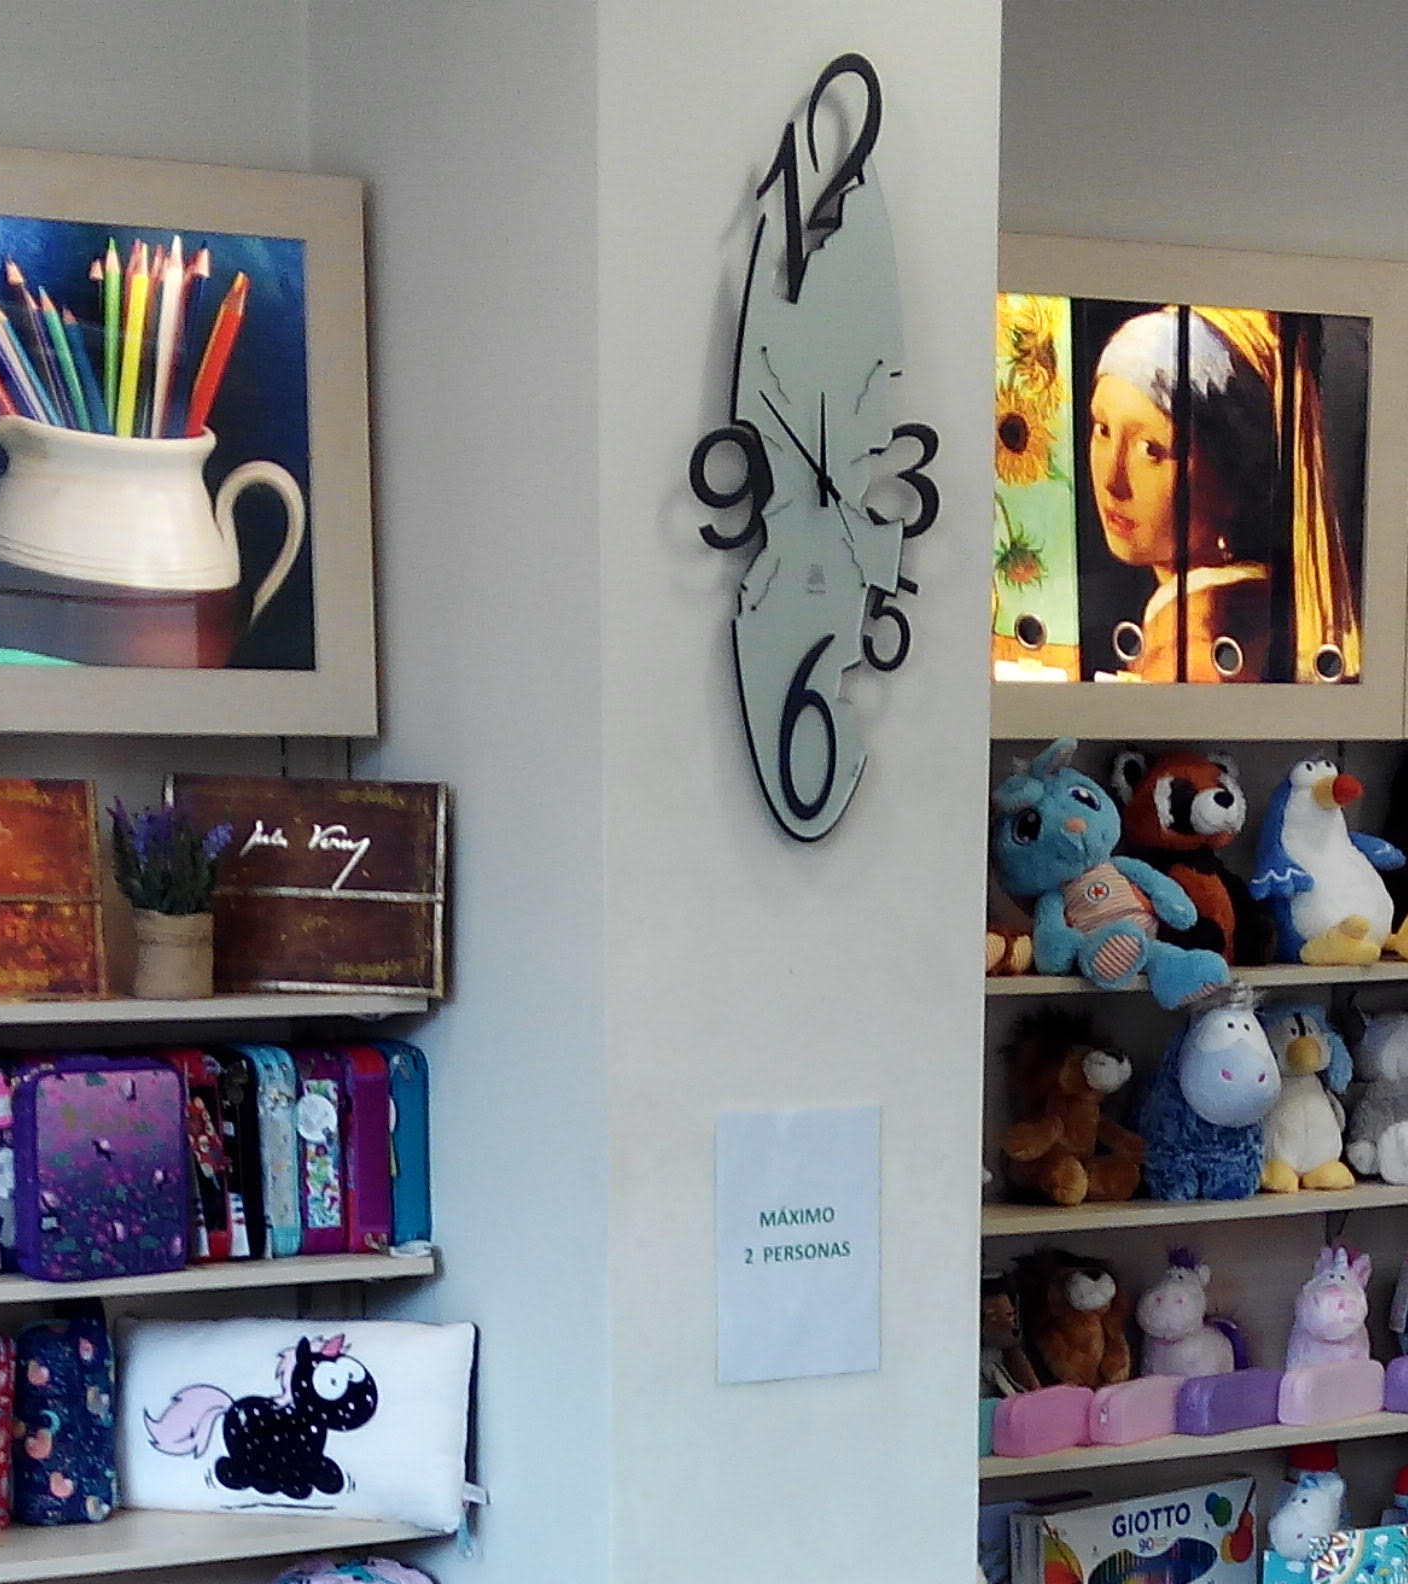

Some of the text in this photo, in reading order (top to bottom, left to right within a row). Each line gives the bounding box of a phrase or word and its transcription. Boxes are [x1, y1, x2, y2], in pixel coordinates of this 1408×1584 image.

[756, 52, 882, 304] 12
[689, 418, 773, 550] 9
[865, 422, 940, 541] 3
[863, 575, 918, 673] 5
[779, 633, 836, 819] 6
[744, 1240, 852, 1265] 2 PERSONAS
[759, 1205, 836, 1229] MÁXIMO
[1112, 1502, 1191, 1538] GIOTTO
